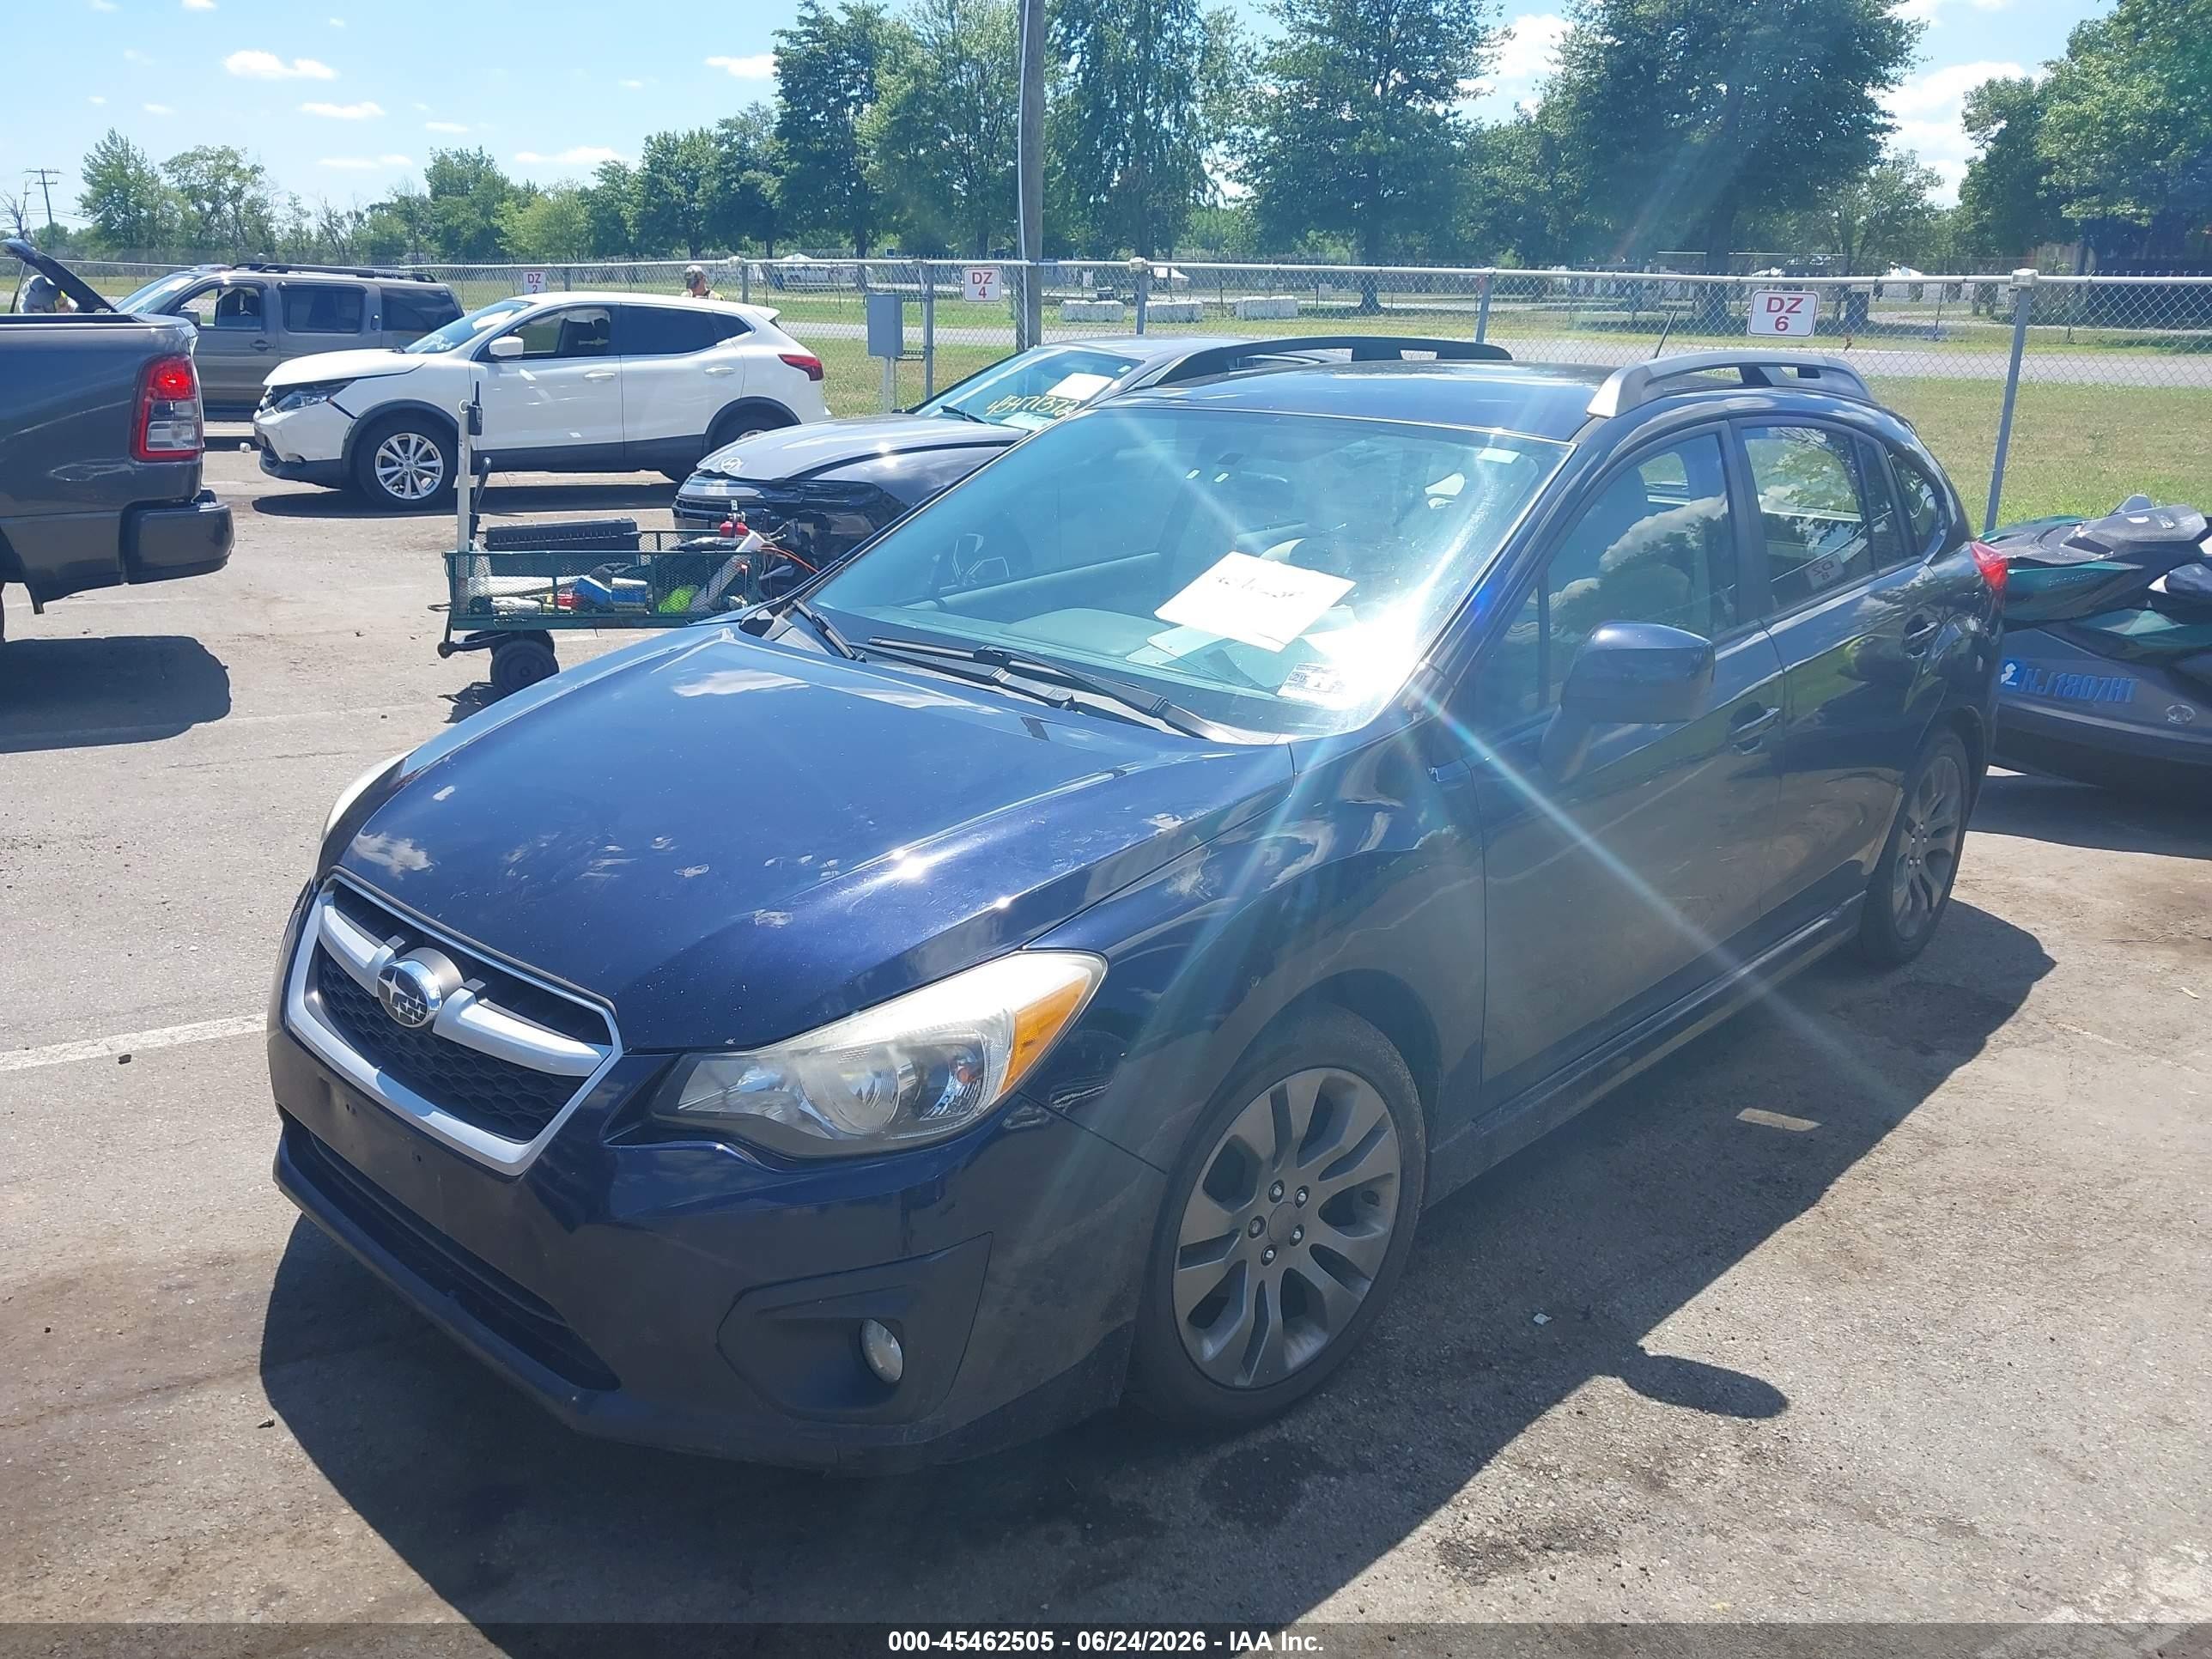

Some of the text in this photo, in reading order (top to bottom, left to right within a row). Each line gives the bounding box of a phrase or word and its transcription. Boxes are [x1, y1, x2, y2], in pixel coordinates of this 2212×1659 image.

[527, 273, 541, 283] DZ
[972, 272, 993, 284] DZ
[532, 285, 538, 294] 2
[978, 287, 988, 298] 4
[1766, 297, 1803, 313] DZ
[1775, 316, 1790, 331] 6
